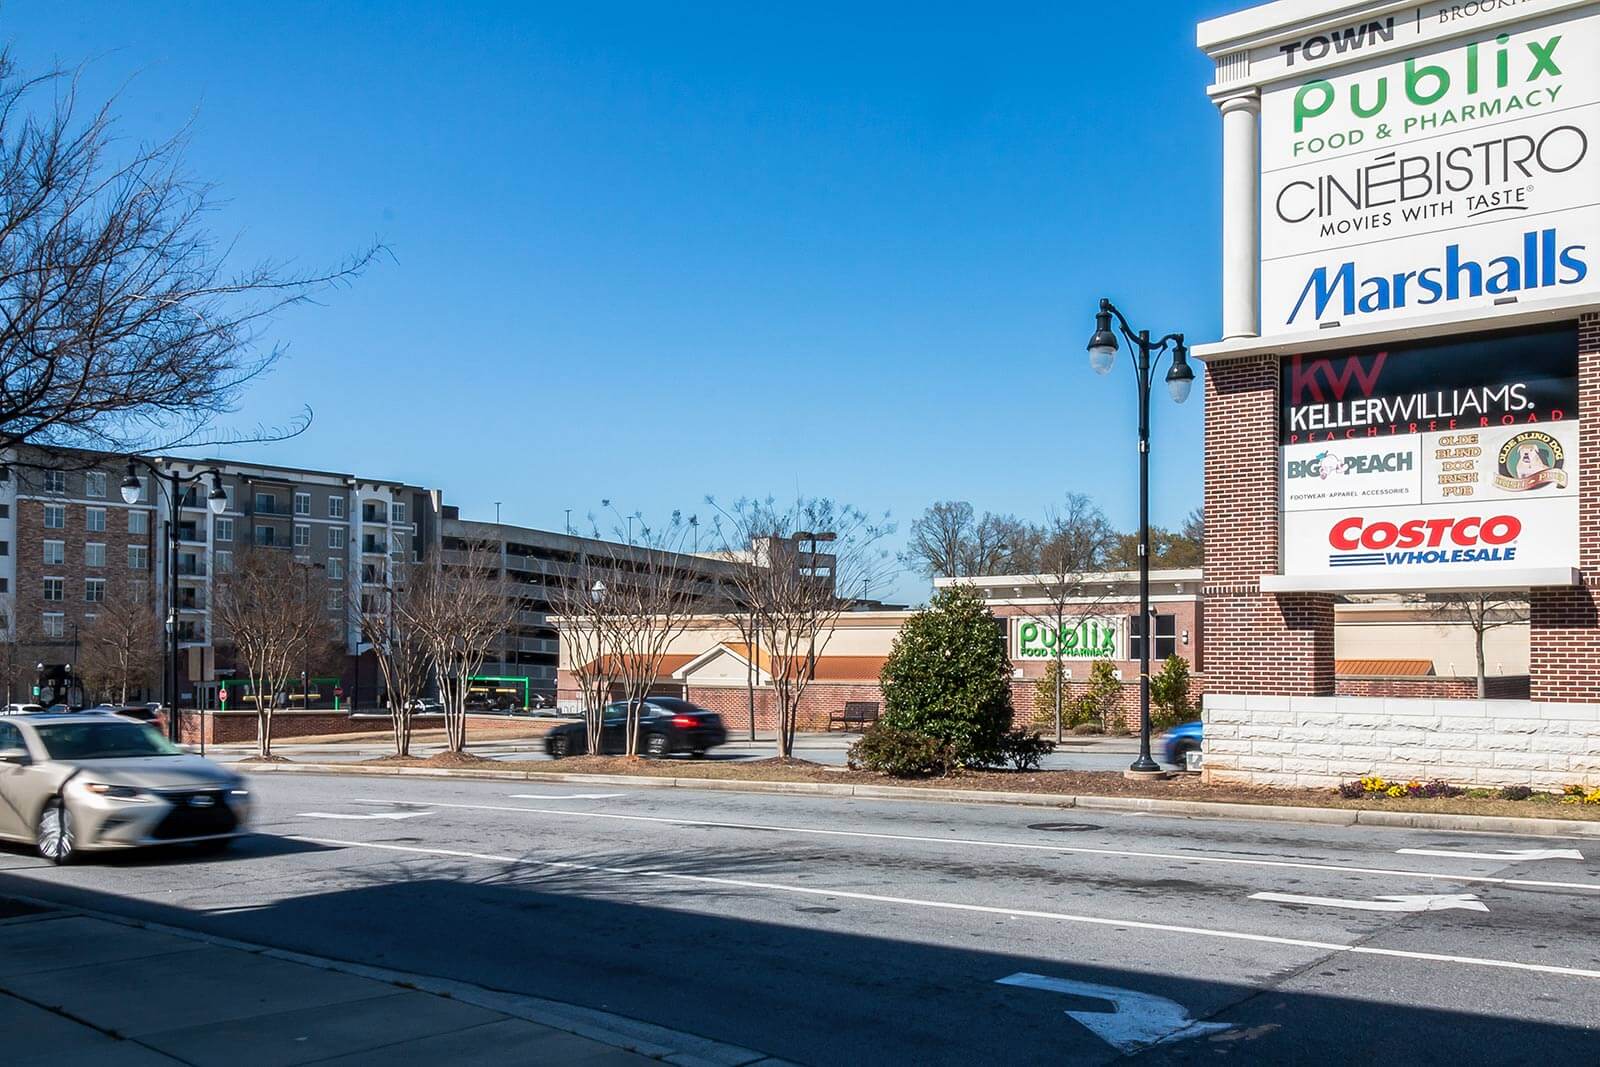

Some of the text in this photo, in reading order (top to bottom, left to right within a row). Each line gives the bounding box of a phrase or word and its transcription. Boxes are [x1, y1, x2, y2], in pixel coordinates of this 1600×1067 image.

[1280, 17, 1395, 67] TOWN
[1293, 33, 1563, 133] Publix
[1293, 85, 1563, 157] FOOD & PHARMACY
[1276, 125, 1588, 223] CINÉBISTRO
[1320, 212, 1392, 238] MOVIES
[1402, 201, 1453, 222] WITH
[1286, 228, 1588, 325] Marshalls
[1291, 409, 1564, 444] PEACHTREE ROAD
[1439, 434, 1479, 446] OLDE
[1435, 447, 1481, 460] BLIND
[1499, 431, 1563, 464] OLDE BLIND DOG
[1287, 451, 1413, 479] BIG PEACH
[1442, 460, 1474, 471] DOG
[1361, 488, 1410, 496] ACCESSORIES
[1443, 486, 1473, 497] PUB
[1328, 515, 1522, 550] COSTCO
[1385, 547, 1517, 565] WHOLESALE
[1020, 621, 1115, 648] Publix
[1020, 647, 1048, 657] FOOD
